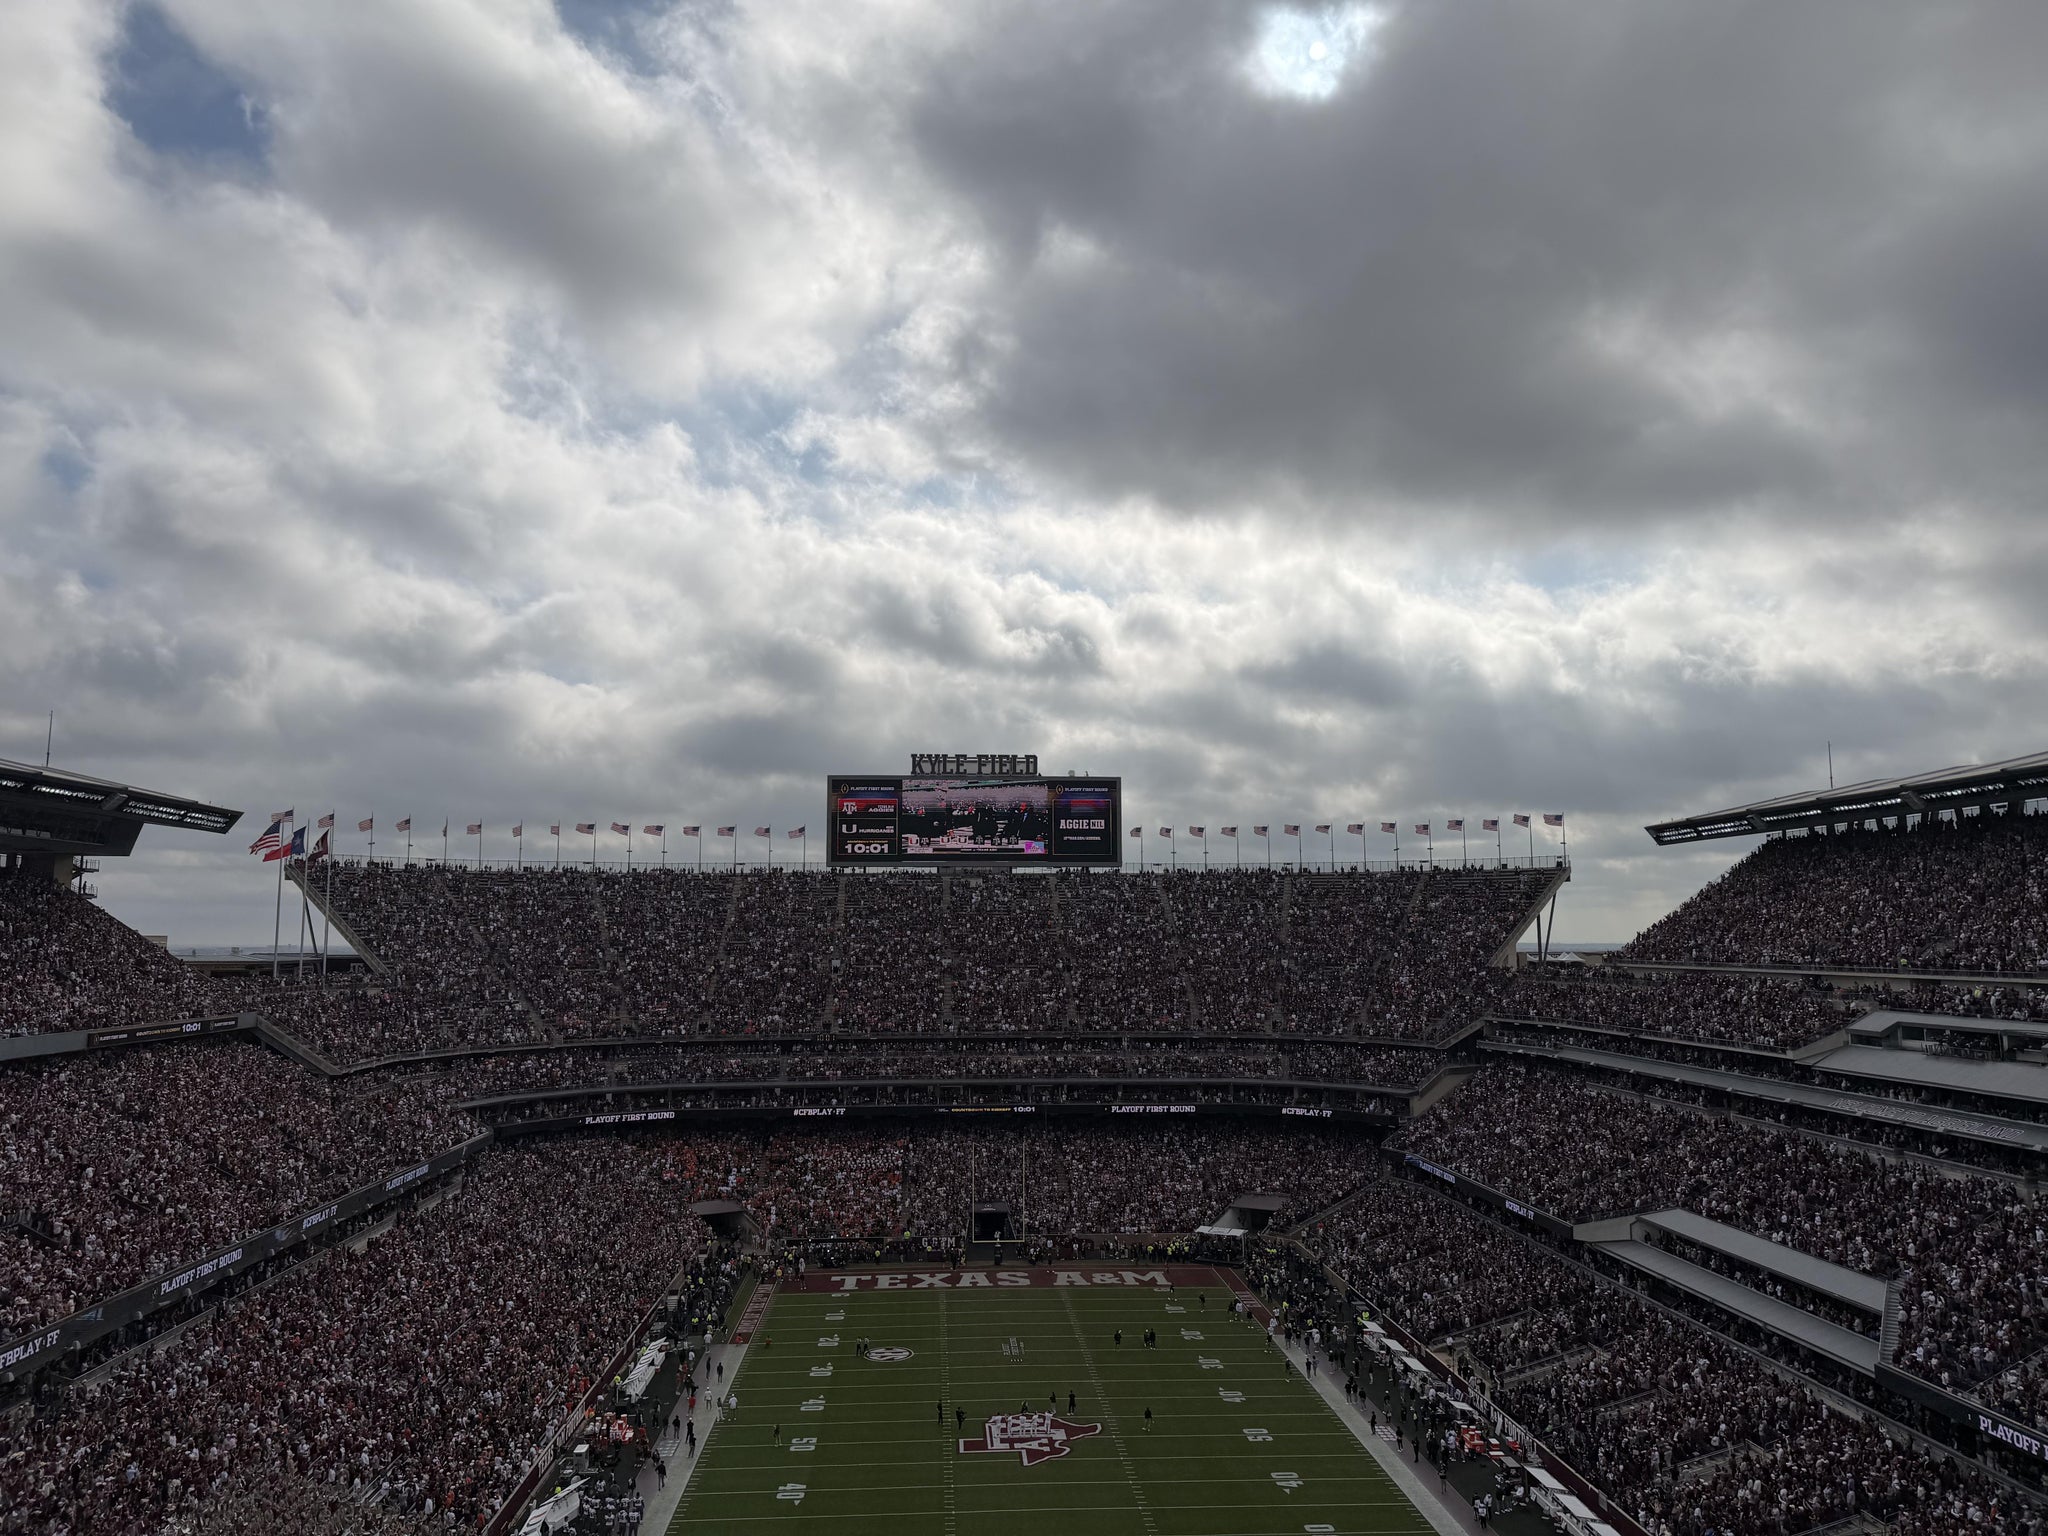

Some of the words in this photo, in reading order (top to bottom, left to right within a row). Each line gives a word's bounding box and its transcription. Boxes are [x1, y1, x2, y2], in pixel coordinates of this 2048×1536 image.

[911, 754, 967, 775] KYLE
[976, 754, 1038, 775] FIELD
[842, 824, 857, 834] U
[1059, 819, 1089, 829] AGGIE
[1090, 819, 1105, 829] NIL
[845, 843, 889, 853] 10:01
[182, 1022, 202, 1033] 10:01
[1111, 1105, 1145, 1113] PLAYOFF
[1169, 1105, 1196, 1113] ROUND
[585, 1115, 621, 1124] PLAYOFF
[622, 1113, 646, 1122] FIRST
[647, 1111, 675, 1120] ROUND
[160, 1268, 196, 1296] PLAYOFF
[195, 1259, 218, 1279] FIRST
[218, 1247, 243, 1269] ROUND
[831, 1271, 1031, 1290] TEXAS
[1053, 1271, 1173, 1286] A&M
[800, 1399, 826, 1411] 40
[1242, 1428, 1274, 1442] 50
[1978, 1414, 2041, 1456] PLAYOFF
[789, 1437, 818, 1452] 50
[1270, 1471, 1305, 1488] 40
[776, 1483, 807, 1500] 40
